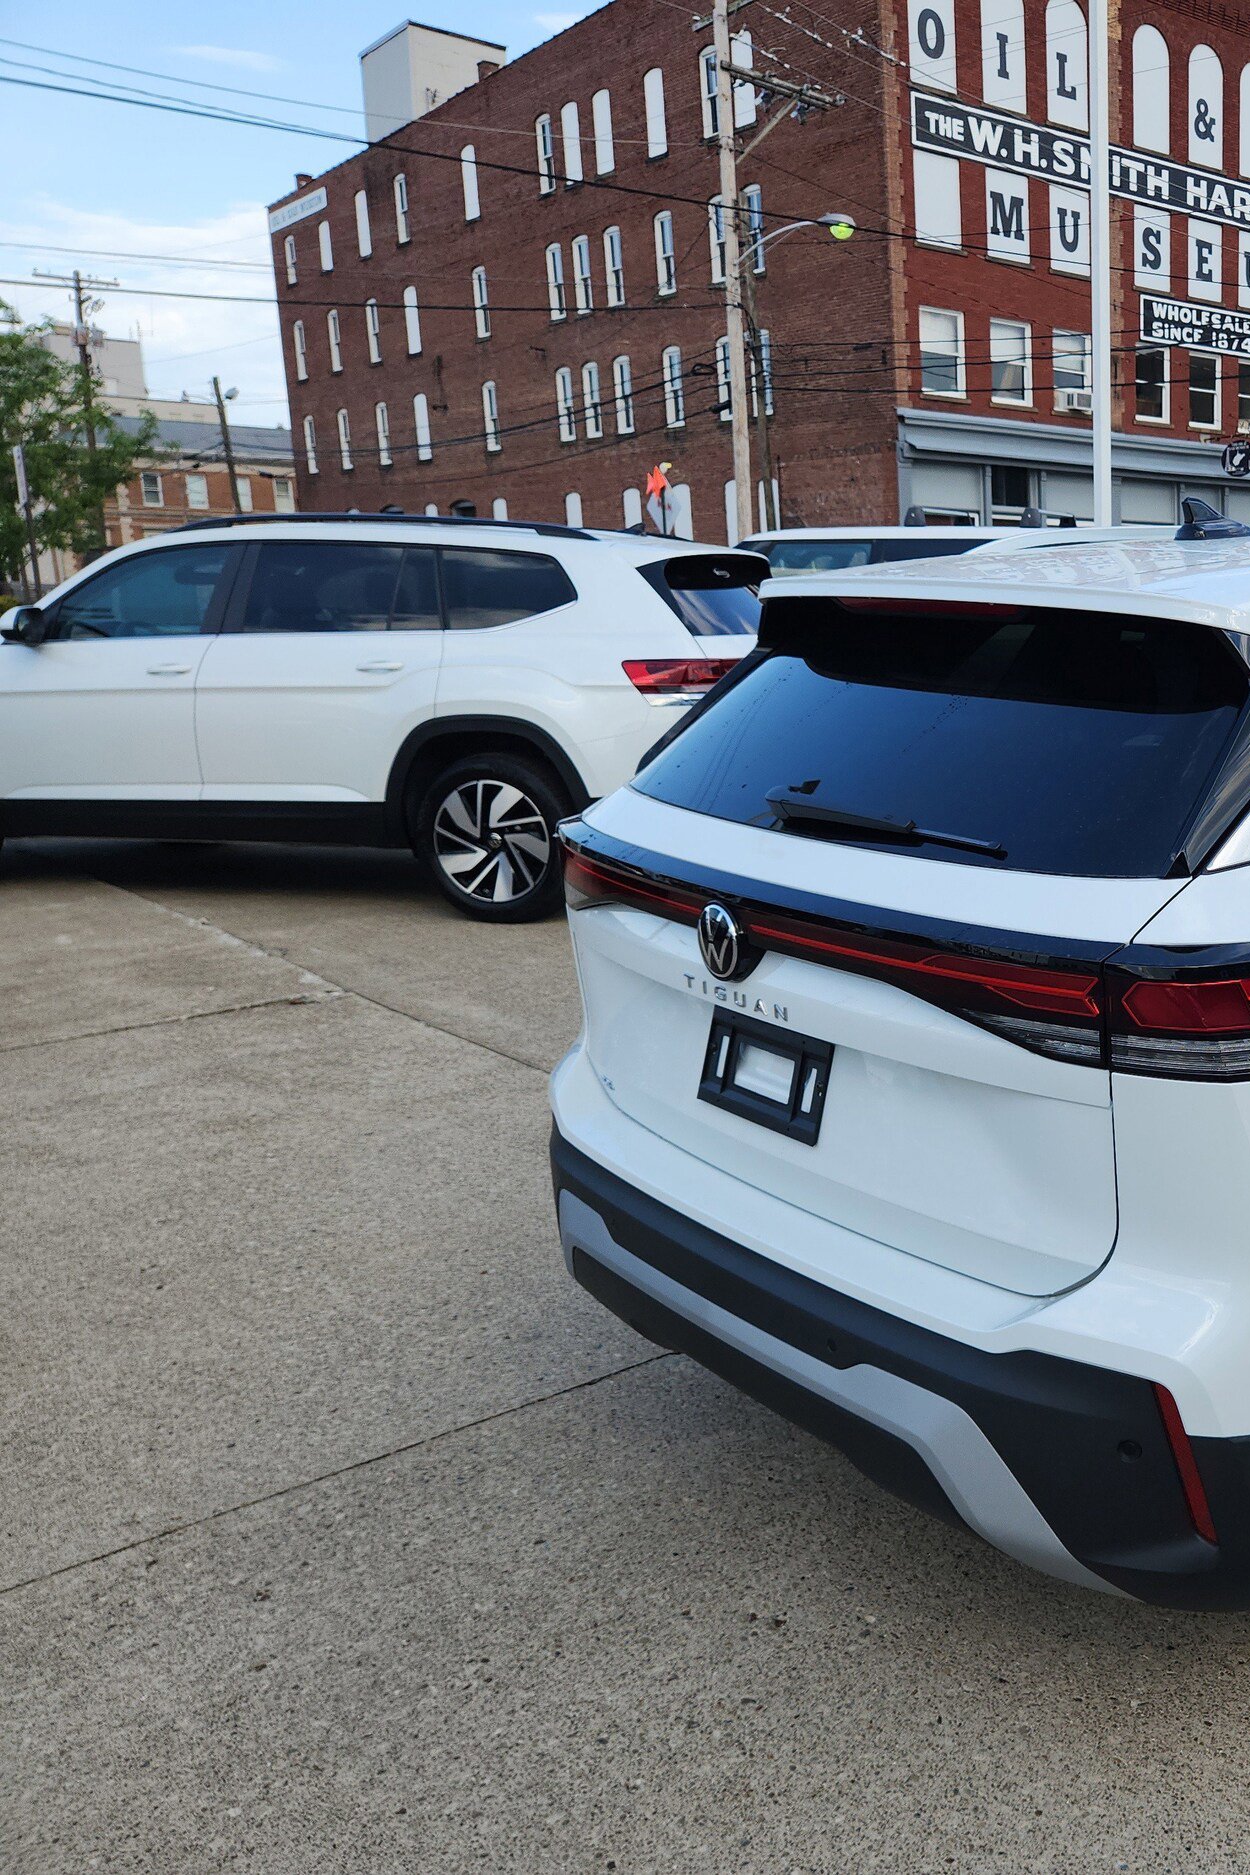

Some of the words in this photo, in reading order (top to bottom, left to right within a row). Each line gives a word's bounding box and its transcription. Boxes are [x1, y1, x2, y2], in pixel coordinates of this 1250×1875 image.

[918, 8, 1077, 100] OIL
[1194, 98, 1216, 143] &
[924, 110, 965, 142] THE
[1151, 321, 1204, 343] SINCE
[683, 973, 788, 1021] TIGUAN
